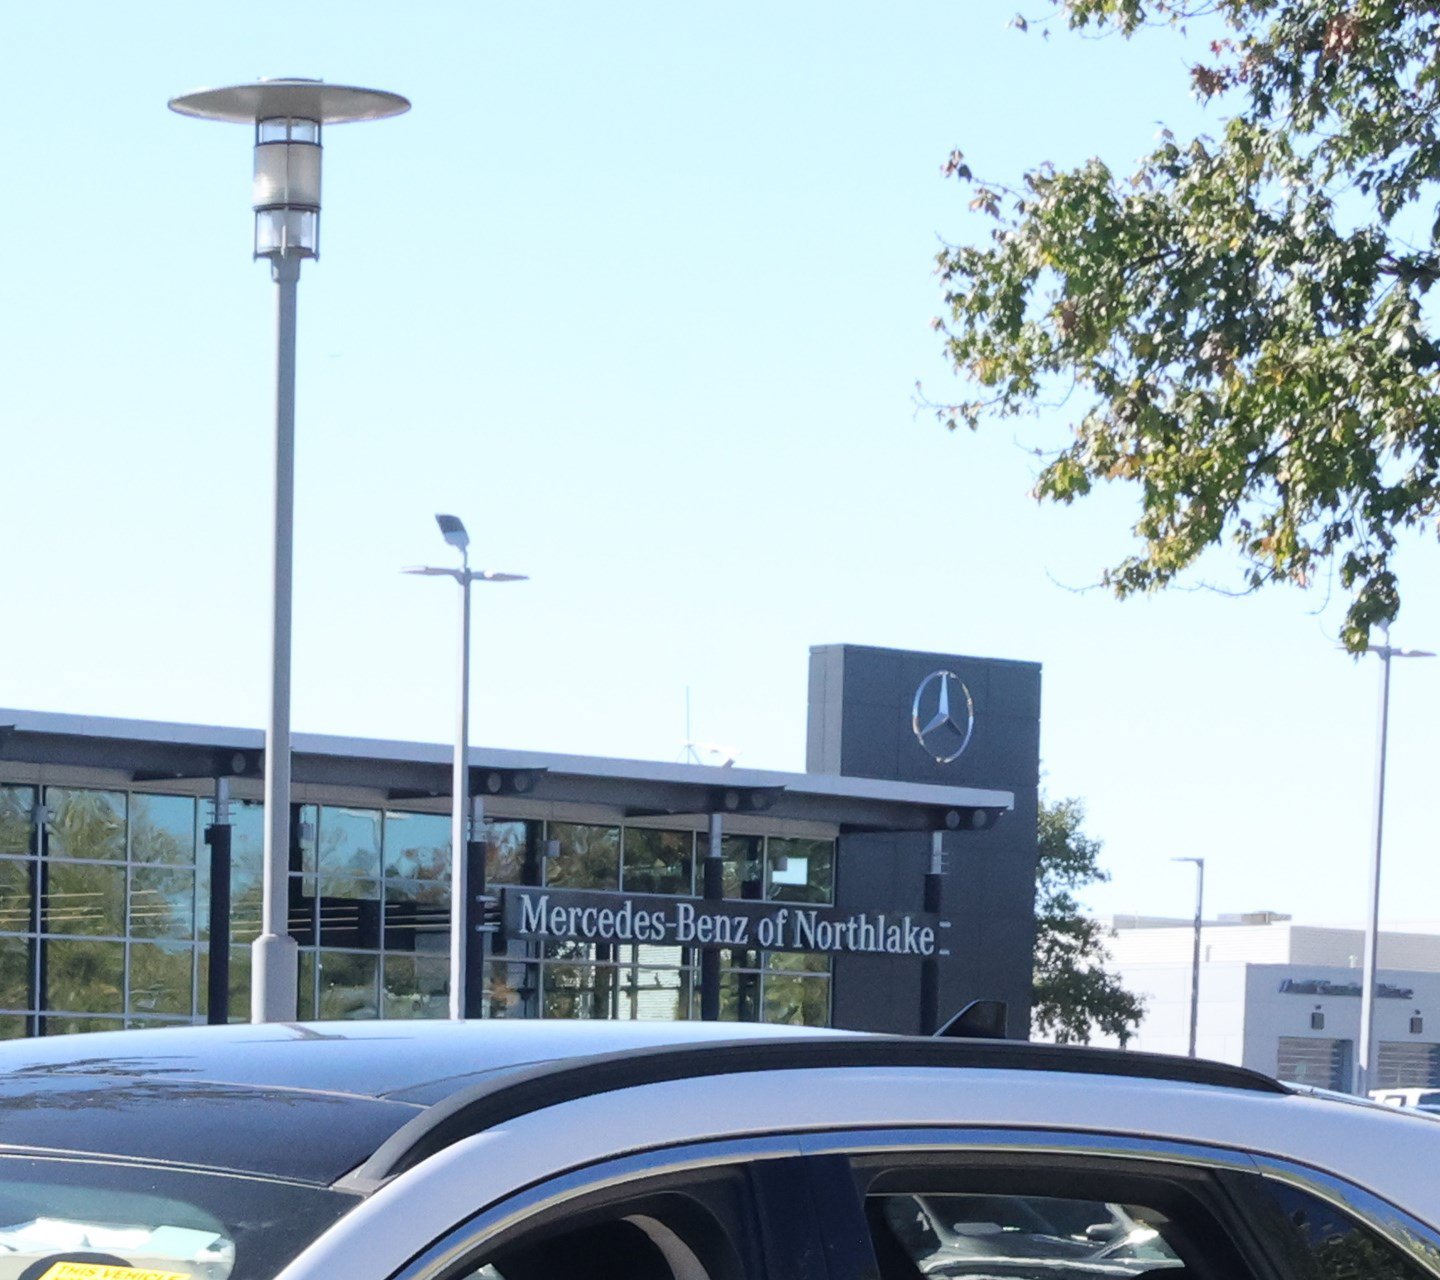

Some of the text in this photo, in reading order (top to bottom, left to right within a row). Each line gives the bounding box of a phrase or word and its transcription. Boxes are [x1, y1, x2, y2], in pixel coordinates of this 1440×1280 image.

[520, 893, 936, 956] Mercedes-Benz of Northlake
[56, 1264, 98, 1277] THIS
